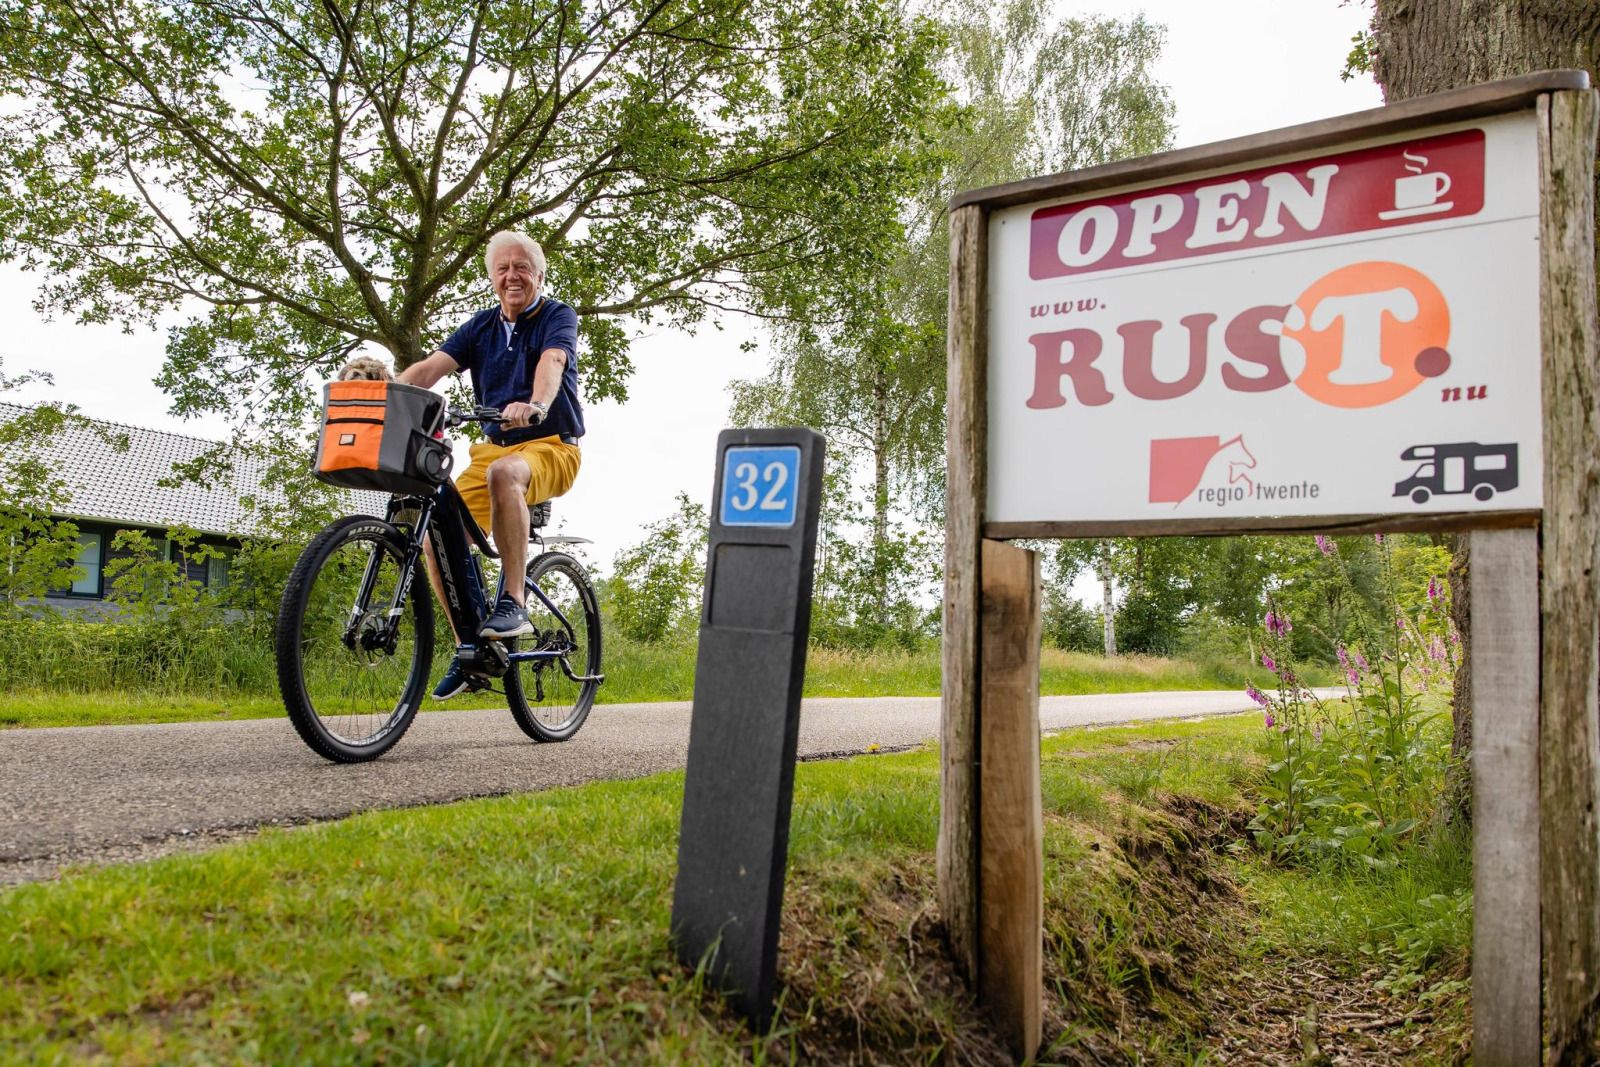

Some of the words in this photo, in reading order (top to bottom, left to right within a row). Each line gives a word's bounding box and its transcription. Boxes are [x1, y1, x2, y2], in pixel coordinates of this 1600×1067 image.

[1058, 164, 1339, 268] OPEN
[1030, 298, 1106, 318] www.
[1441, 383, 1487, 402] nu
[731, 462, 788, 511] 32
[1198, 484, 1244, 507] regio
[1256, 480, 1320, 500] twente
[348, 525, 386, 536] MAXXIS
[446, 581, 460, 610] FOX
